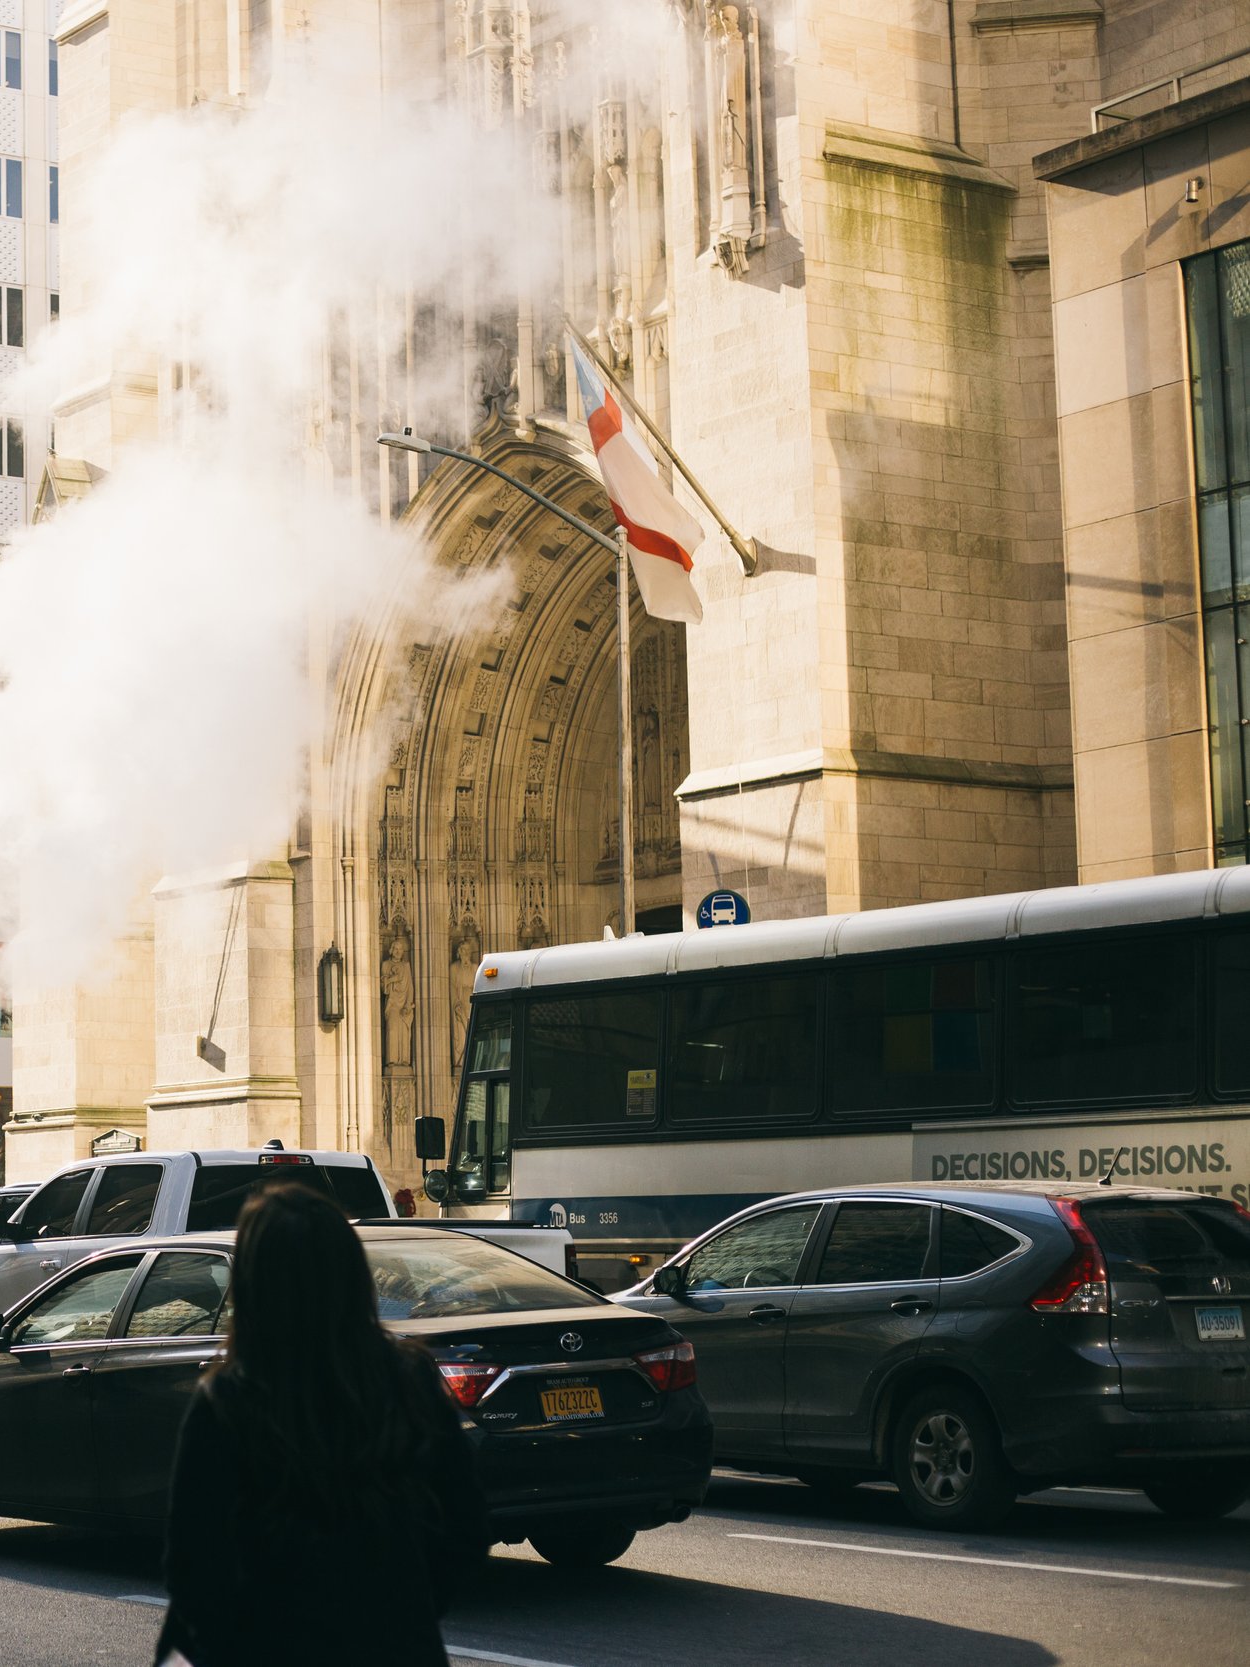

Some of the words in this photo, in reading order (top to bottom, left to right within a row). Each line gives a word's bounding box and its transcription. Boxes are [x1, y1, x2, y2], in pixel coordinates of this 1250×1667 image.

[931, 1149, 1072, 1182] DECISIONS,
[1078, 1142, 1232, 1178] DECISIONS.
[569, 1212, 586, 1224] Bus
[599, 1212, 618, 1224] 3356
[544, 1389, 598, 1412] T762322C
